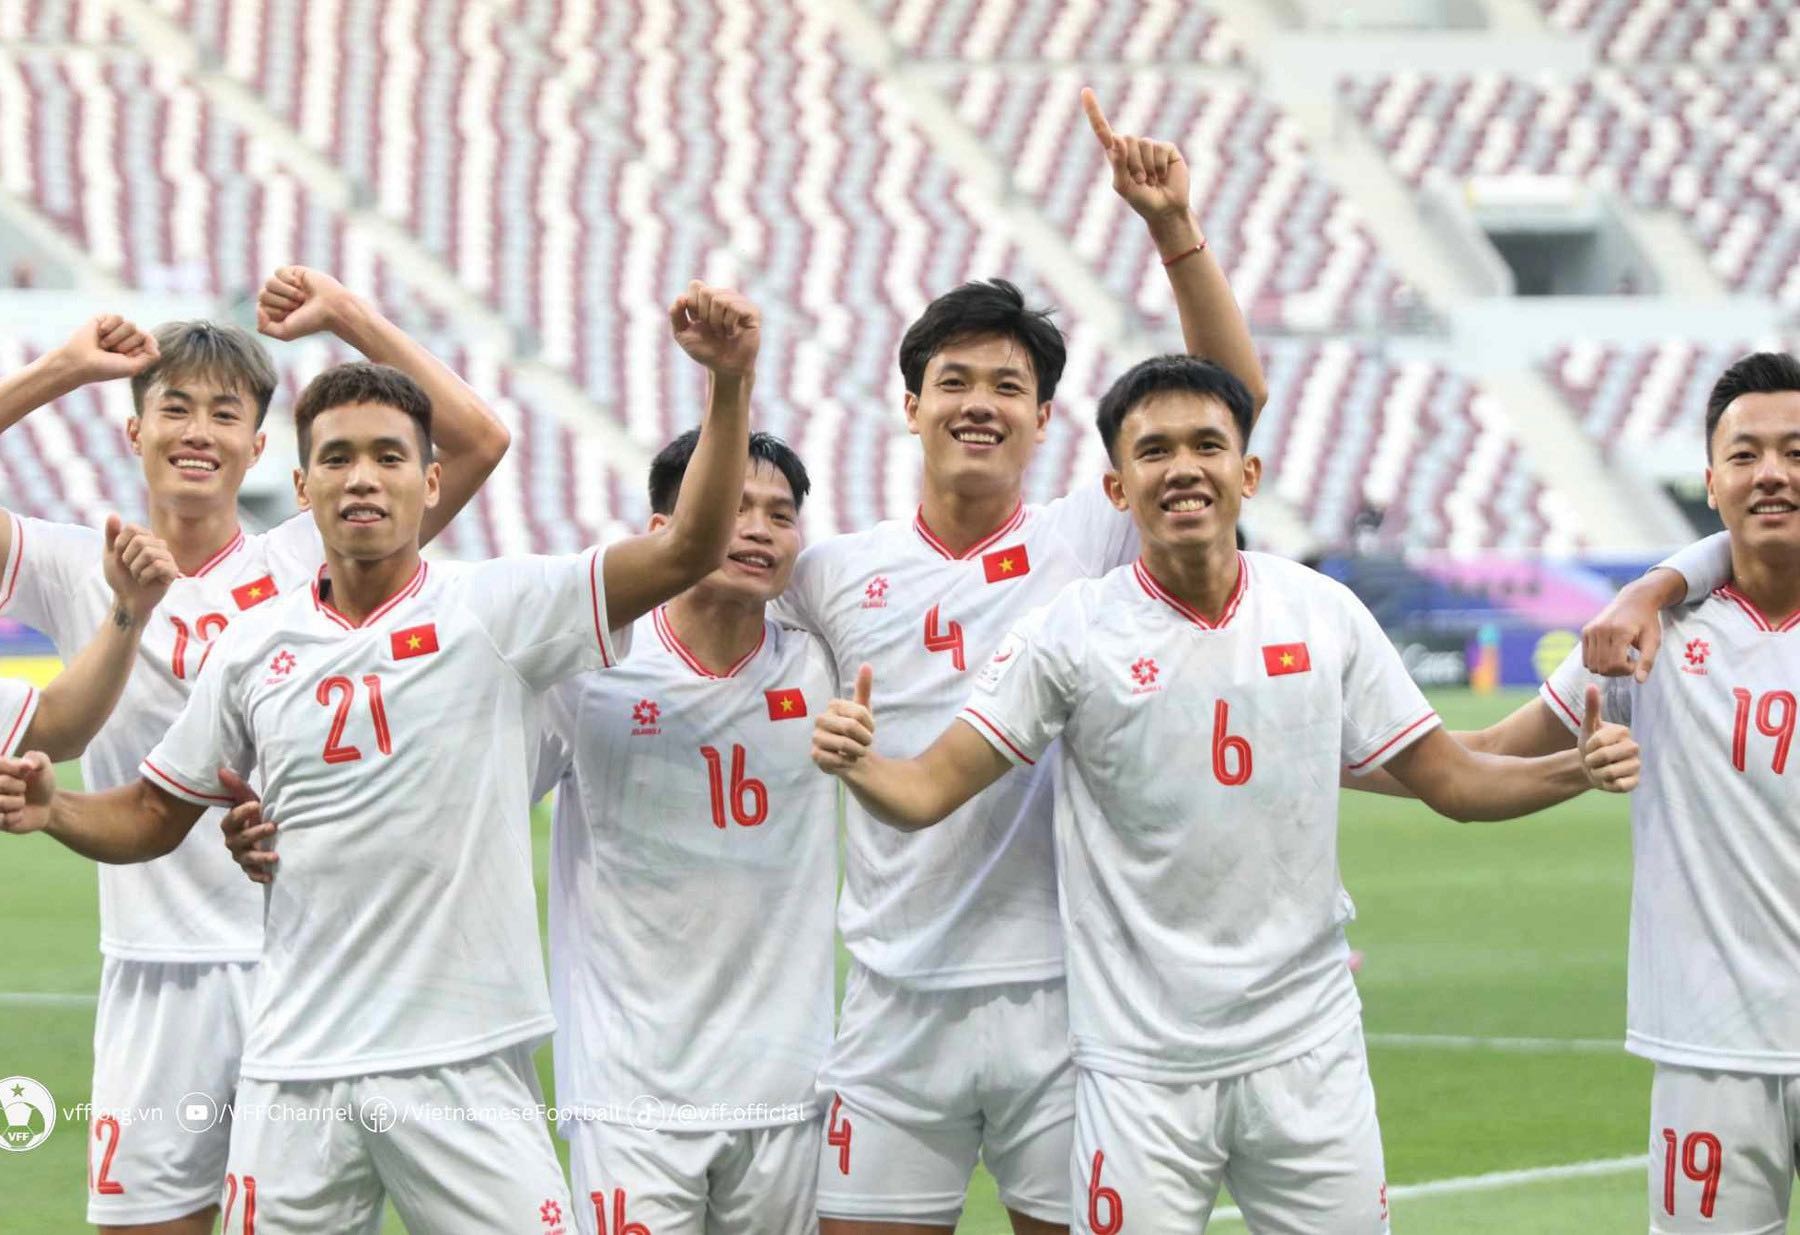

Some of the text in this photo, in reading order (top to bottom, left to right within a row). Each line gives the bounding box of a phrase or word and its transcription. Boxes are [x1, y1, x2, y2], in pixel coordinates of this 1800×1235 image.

[924, 607, 966, 671] 4
[316, 675, 391, 764] 21
[1212, 699, 1253, 786] 6
[1732, 688, 1797, 775] 19
[700, 744, 768, 829] 16
[827, 1090, 853, 1175] 4
[1662, 1129, 1722, 1218] 19
[1087, 1149, 1123, 1235] 6
